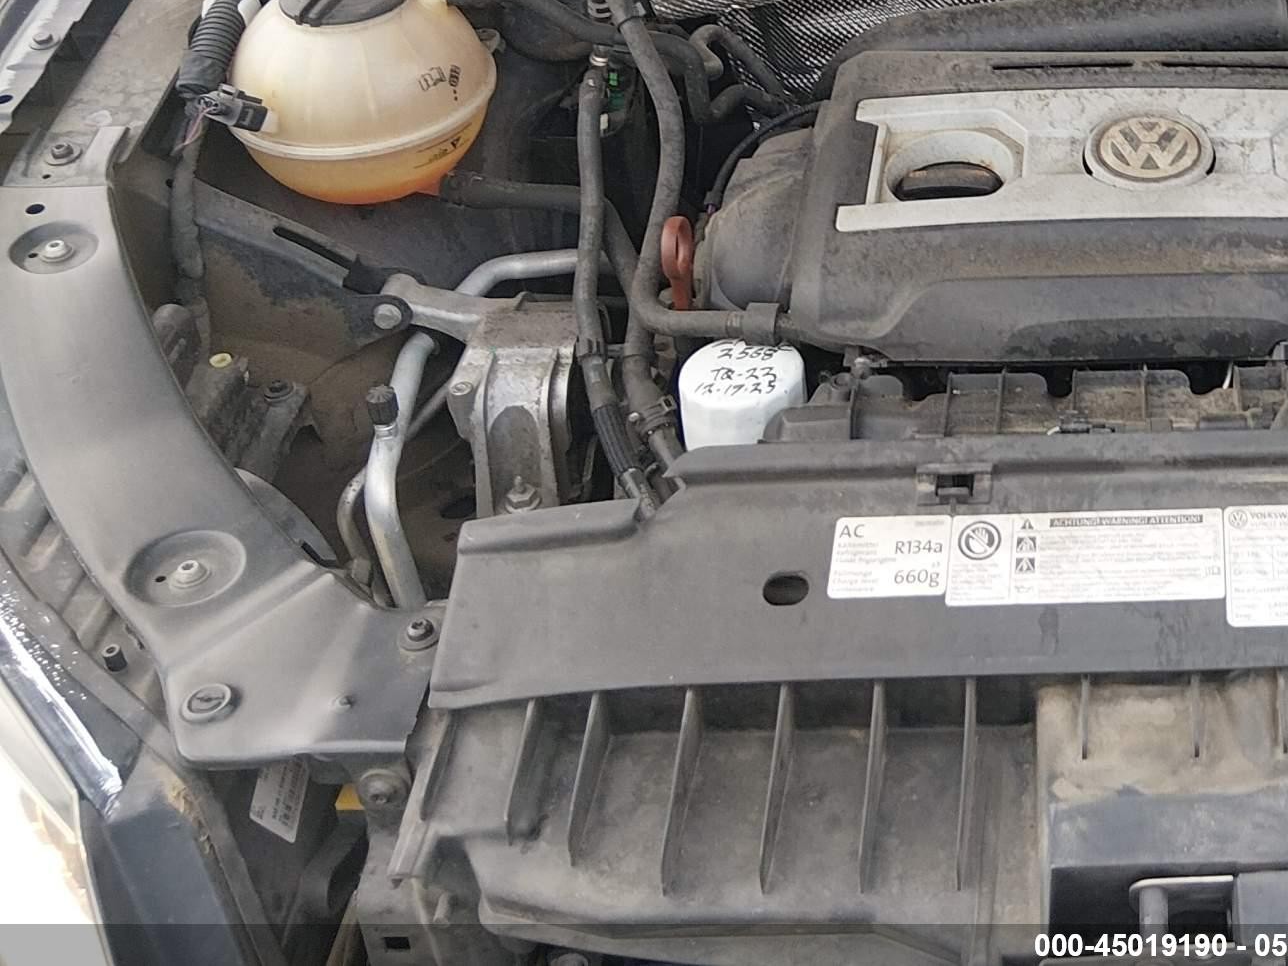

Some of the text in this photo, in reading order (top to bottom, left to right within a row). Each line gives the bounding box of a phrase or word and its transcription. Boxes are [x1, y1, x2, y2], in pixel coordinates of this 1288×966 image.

[839, 524, 865, 538] AC
[894, 540, 943, 554] R134a
[894, 569, 940, 588] 660g
